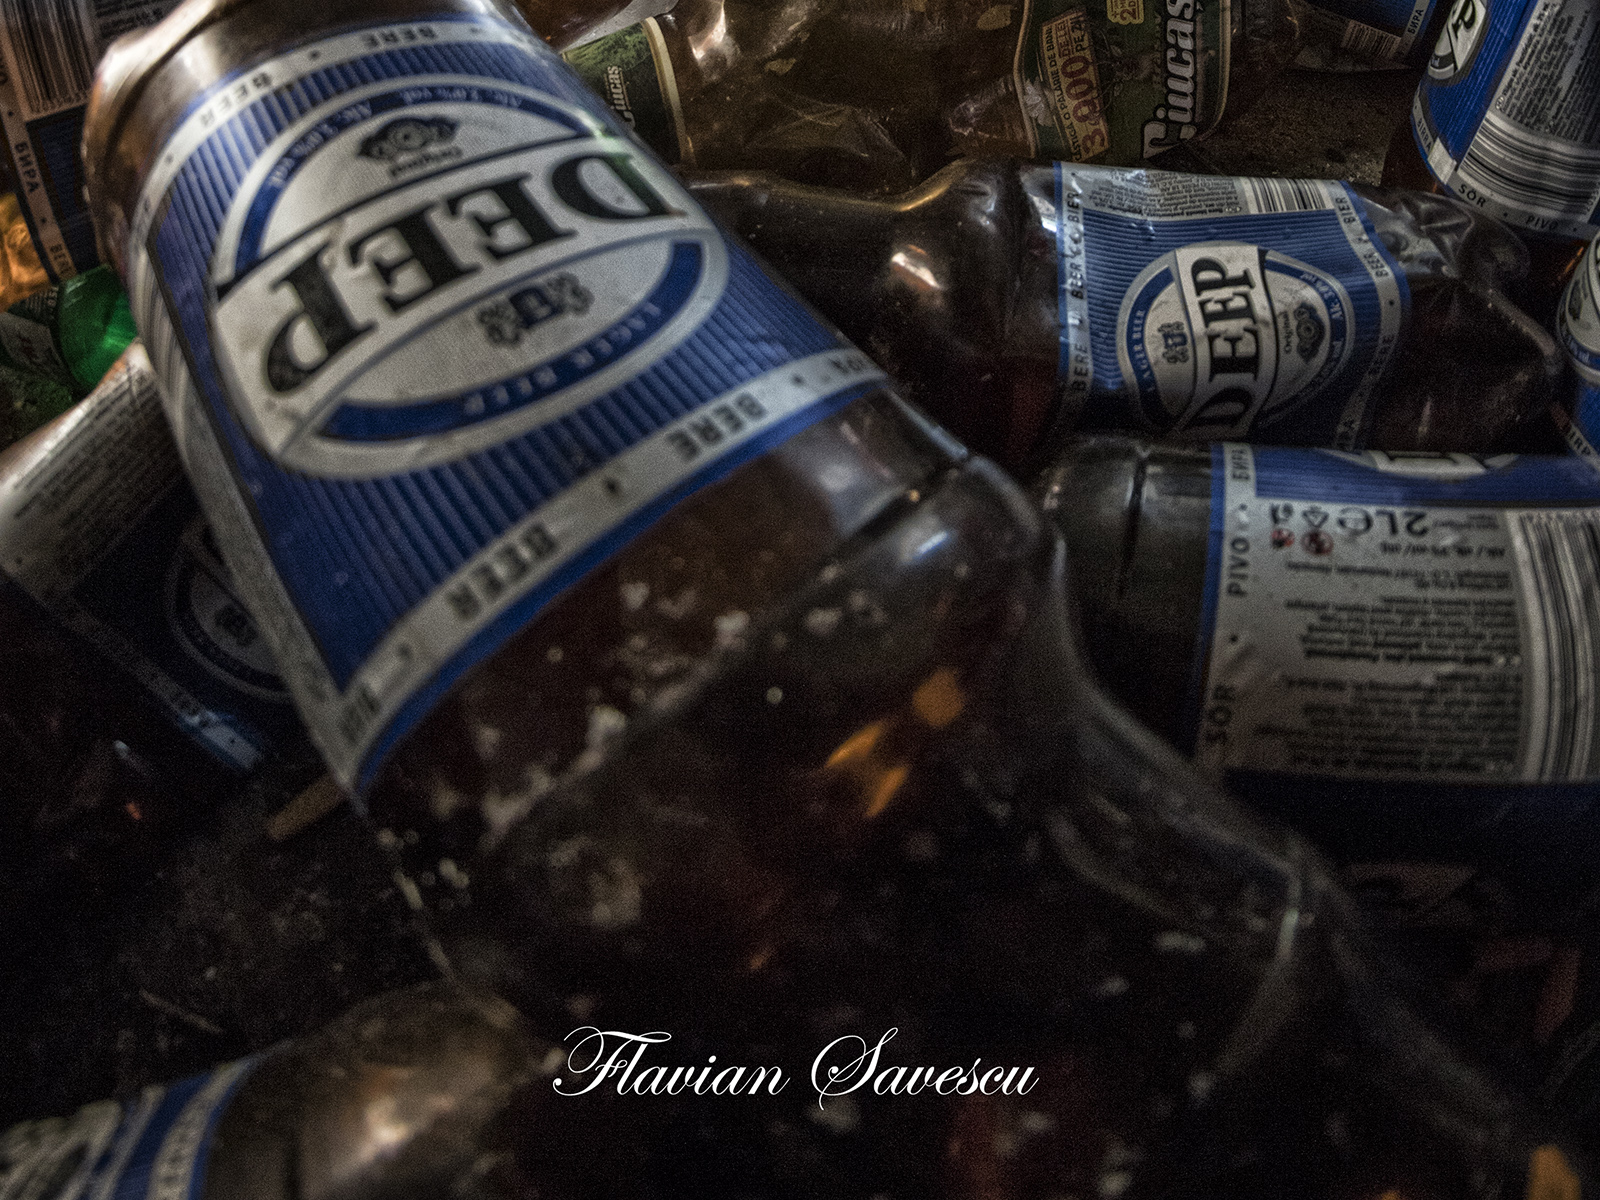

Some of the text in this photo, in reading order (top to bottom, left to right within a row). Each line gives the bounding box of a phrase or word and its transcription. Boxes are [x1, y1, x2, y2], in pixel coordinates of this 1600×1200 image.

[1120, 8, 1137, 21] 2
[363, 26, 438, 52] BERE
[1058, 20, 1070, 57] DE LEI
[1075, 35, 1085, 51] PE
[1048, 53, 1056, 67] DE
[200, 72, 273, 128] BEER
[1063, 111, 1072, 121] O
[14, 140, 40, 194] БИРА
[1334, 198, 1356, 224] BIER
[1458, 184, 1486, 208] SÖR
[1526, 211, 1559, 231] PIVO
[264, 151, 688, 393] DEEP
[1363, 250, 1388, 278] BEER
[1131, 310, 1146, 340] BEER
[463, 302, 660, 414] LAGER BEER
[1190, 258, 1259, 430] DEEP
[1072, 343, 1090, 390] BERE
[668, 392, 767, 464] BERE
[446, 521, 558, 622] BEER
[1228, 538, 1250, 598] PIVO
